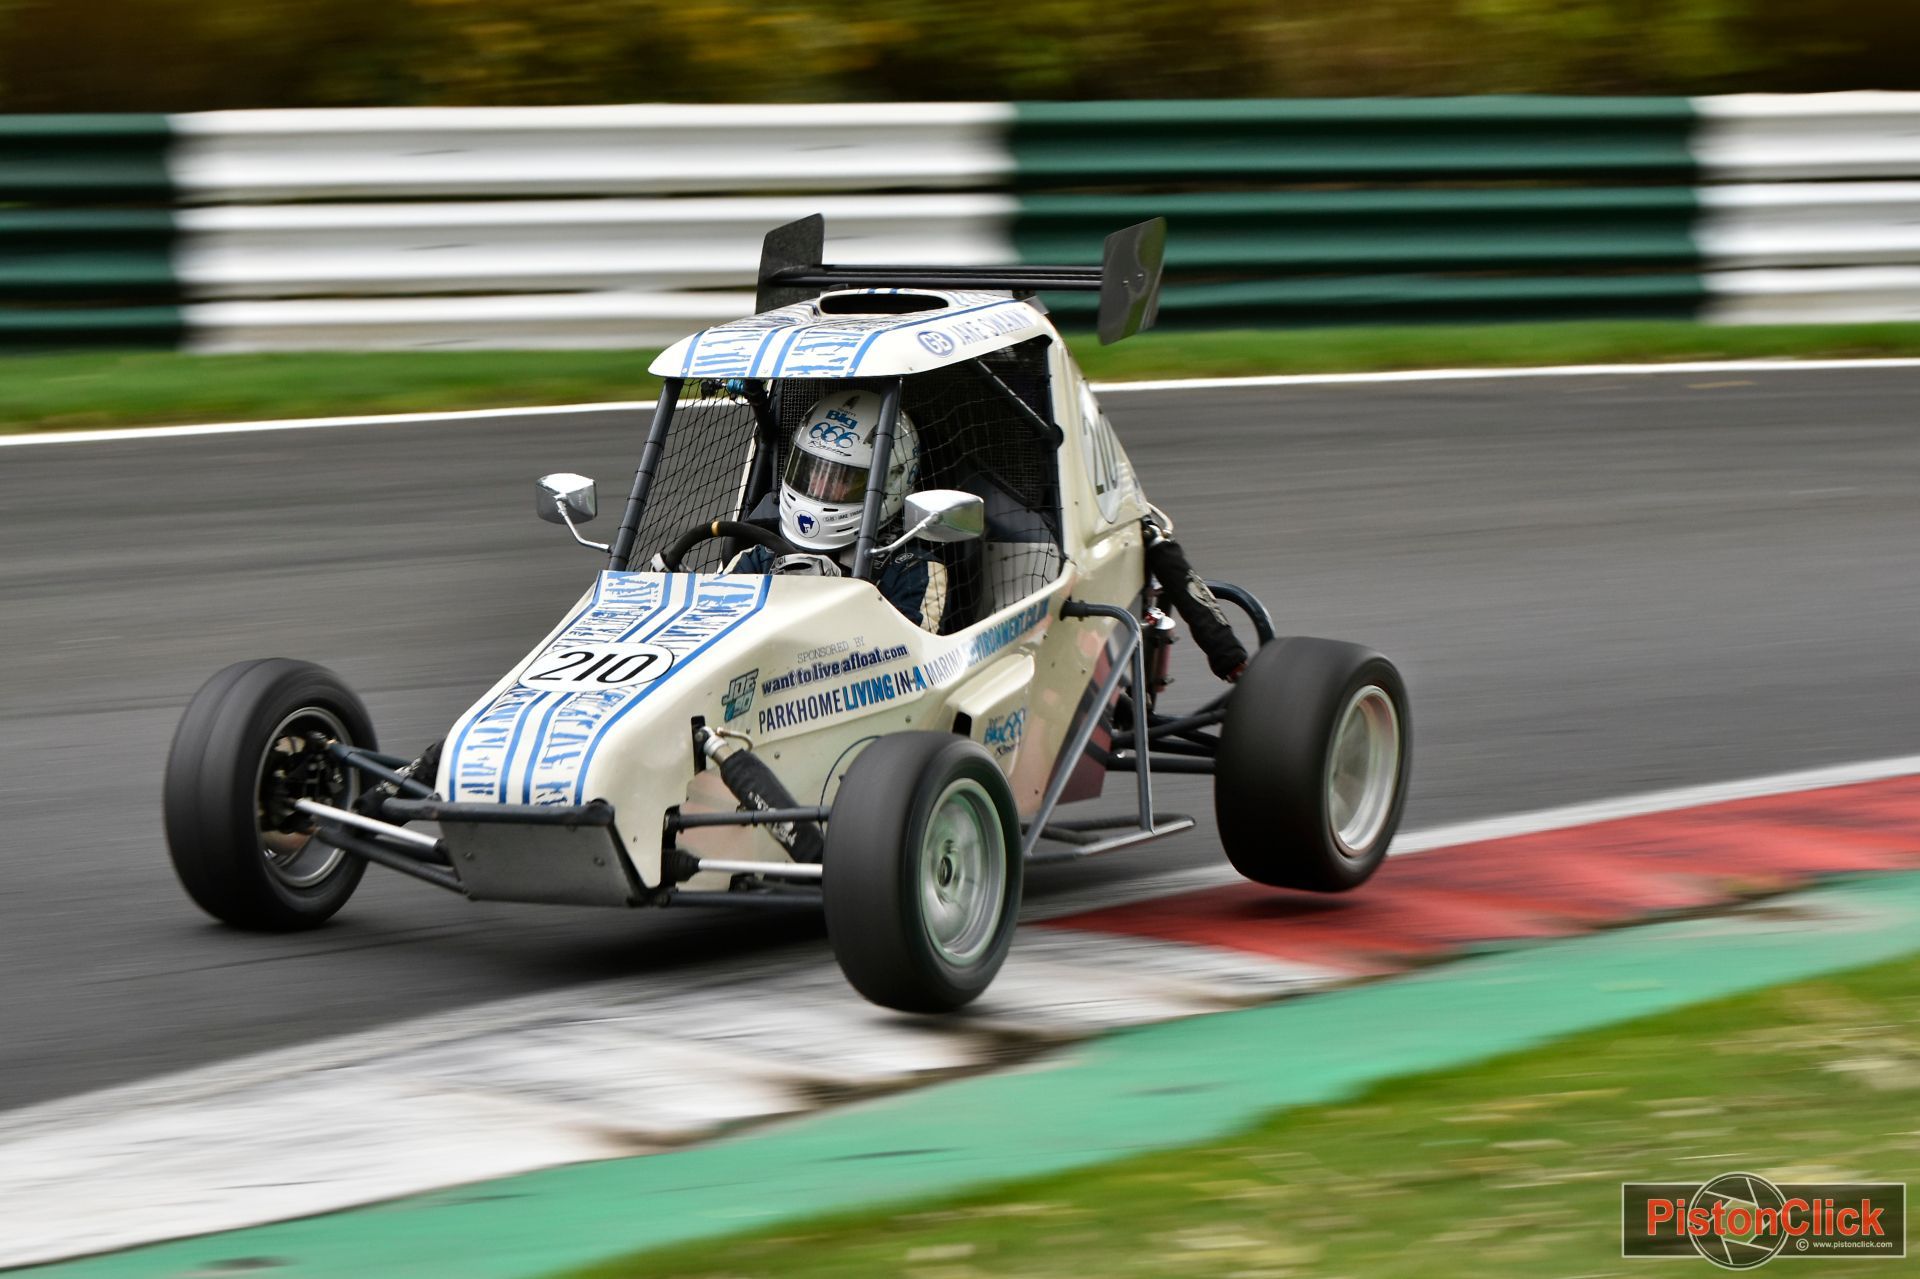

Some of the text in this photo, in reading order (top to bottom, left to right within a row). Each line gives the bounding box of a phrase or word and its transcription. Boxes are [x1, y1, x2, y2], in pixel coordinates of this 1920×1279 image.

[920, 331, 953, 354] GB
[797, 636, 865, 664] SPONSORED BY
[529, 651, 658, 684] 210
